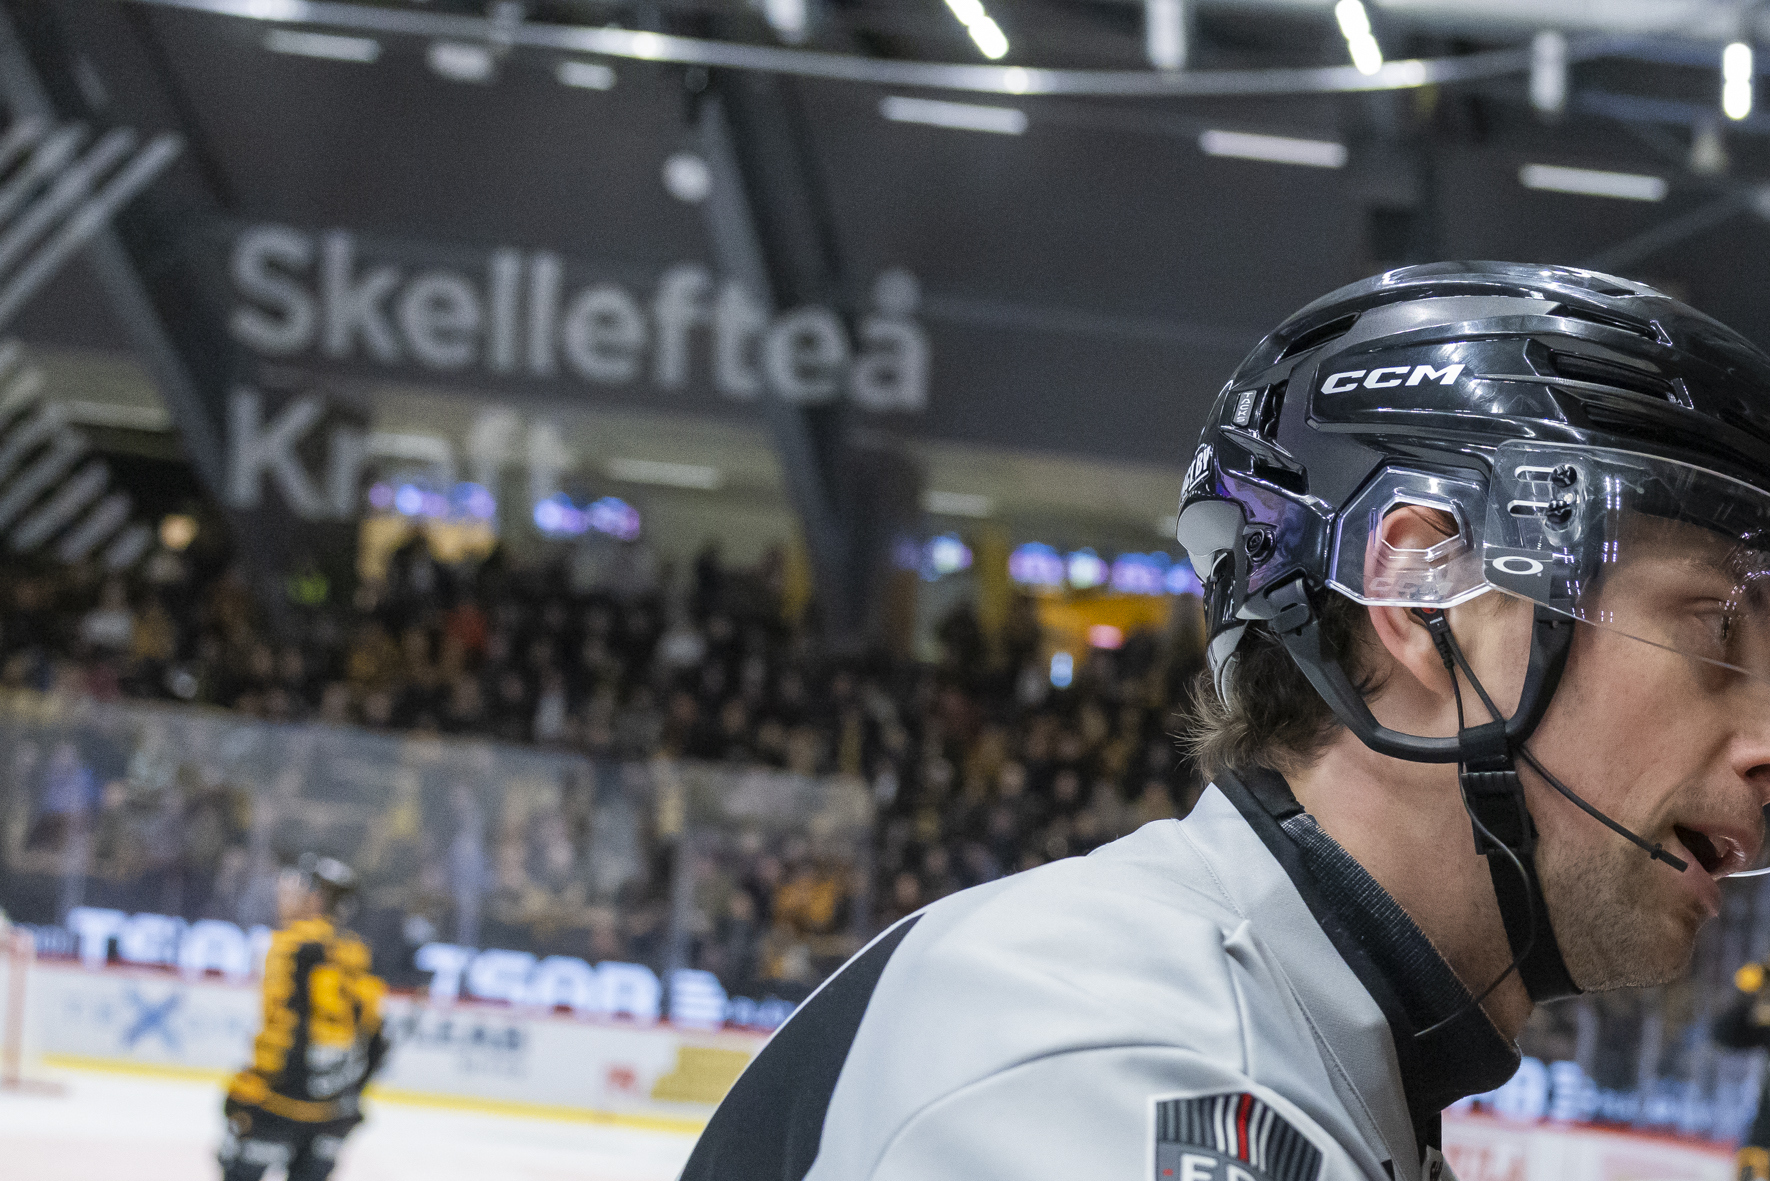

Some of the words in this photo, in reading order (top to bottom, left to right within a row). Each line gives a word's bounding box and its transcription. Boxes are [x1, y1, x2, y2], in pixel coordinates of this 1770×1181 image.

[230, 224, 935, 412] Skellefteå
[1320, 363, 1465, 395] CCM
[226, 385, 572, 530] Krft
